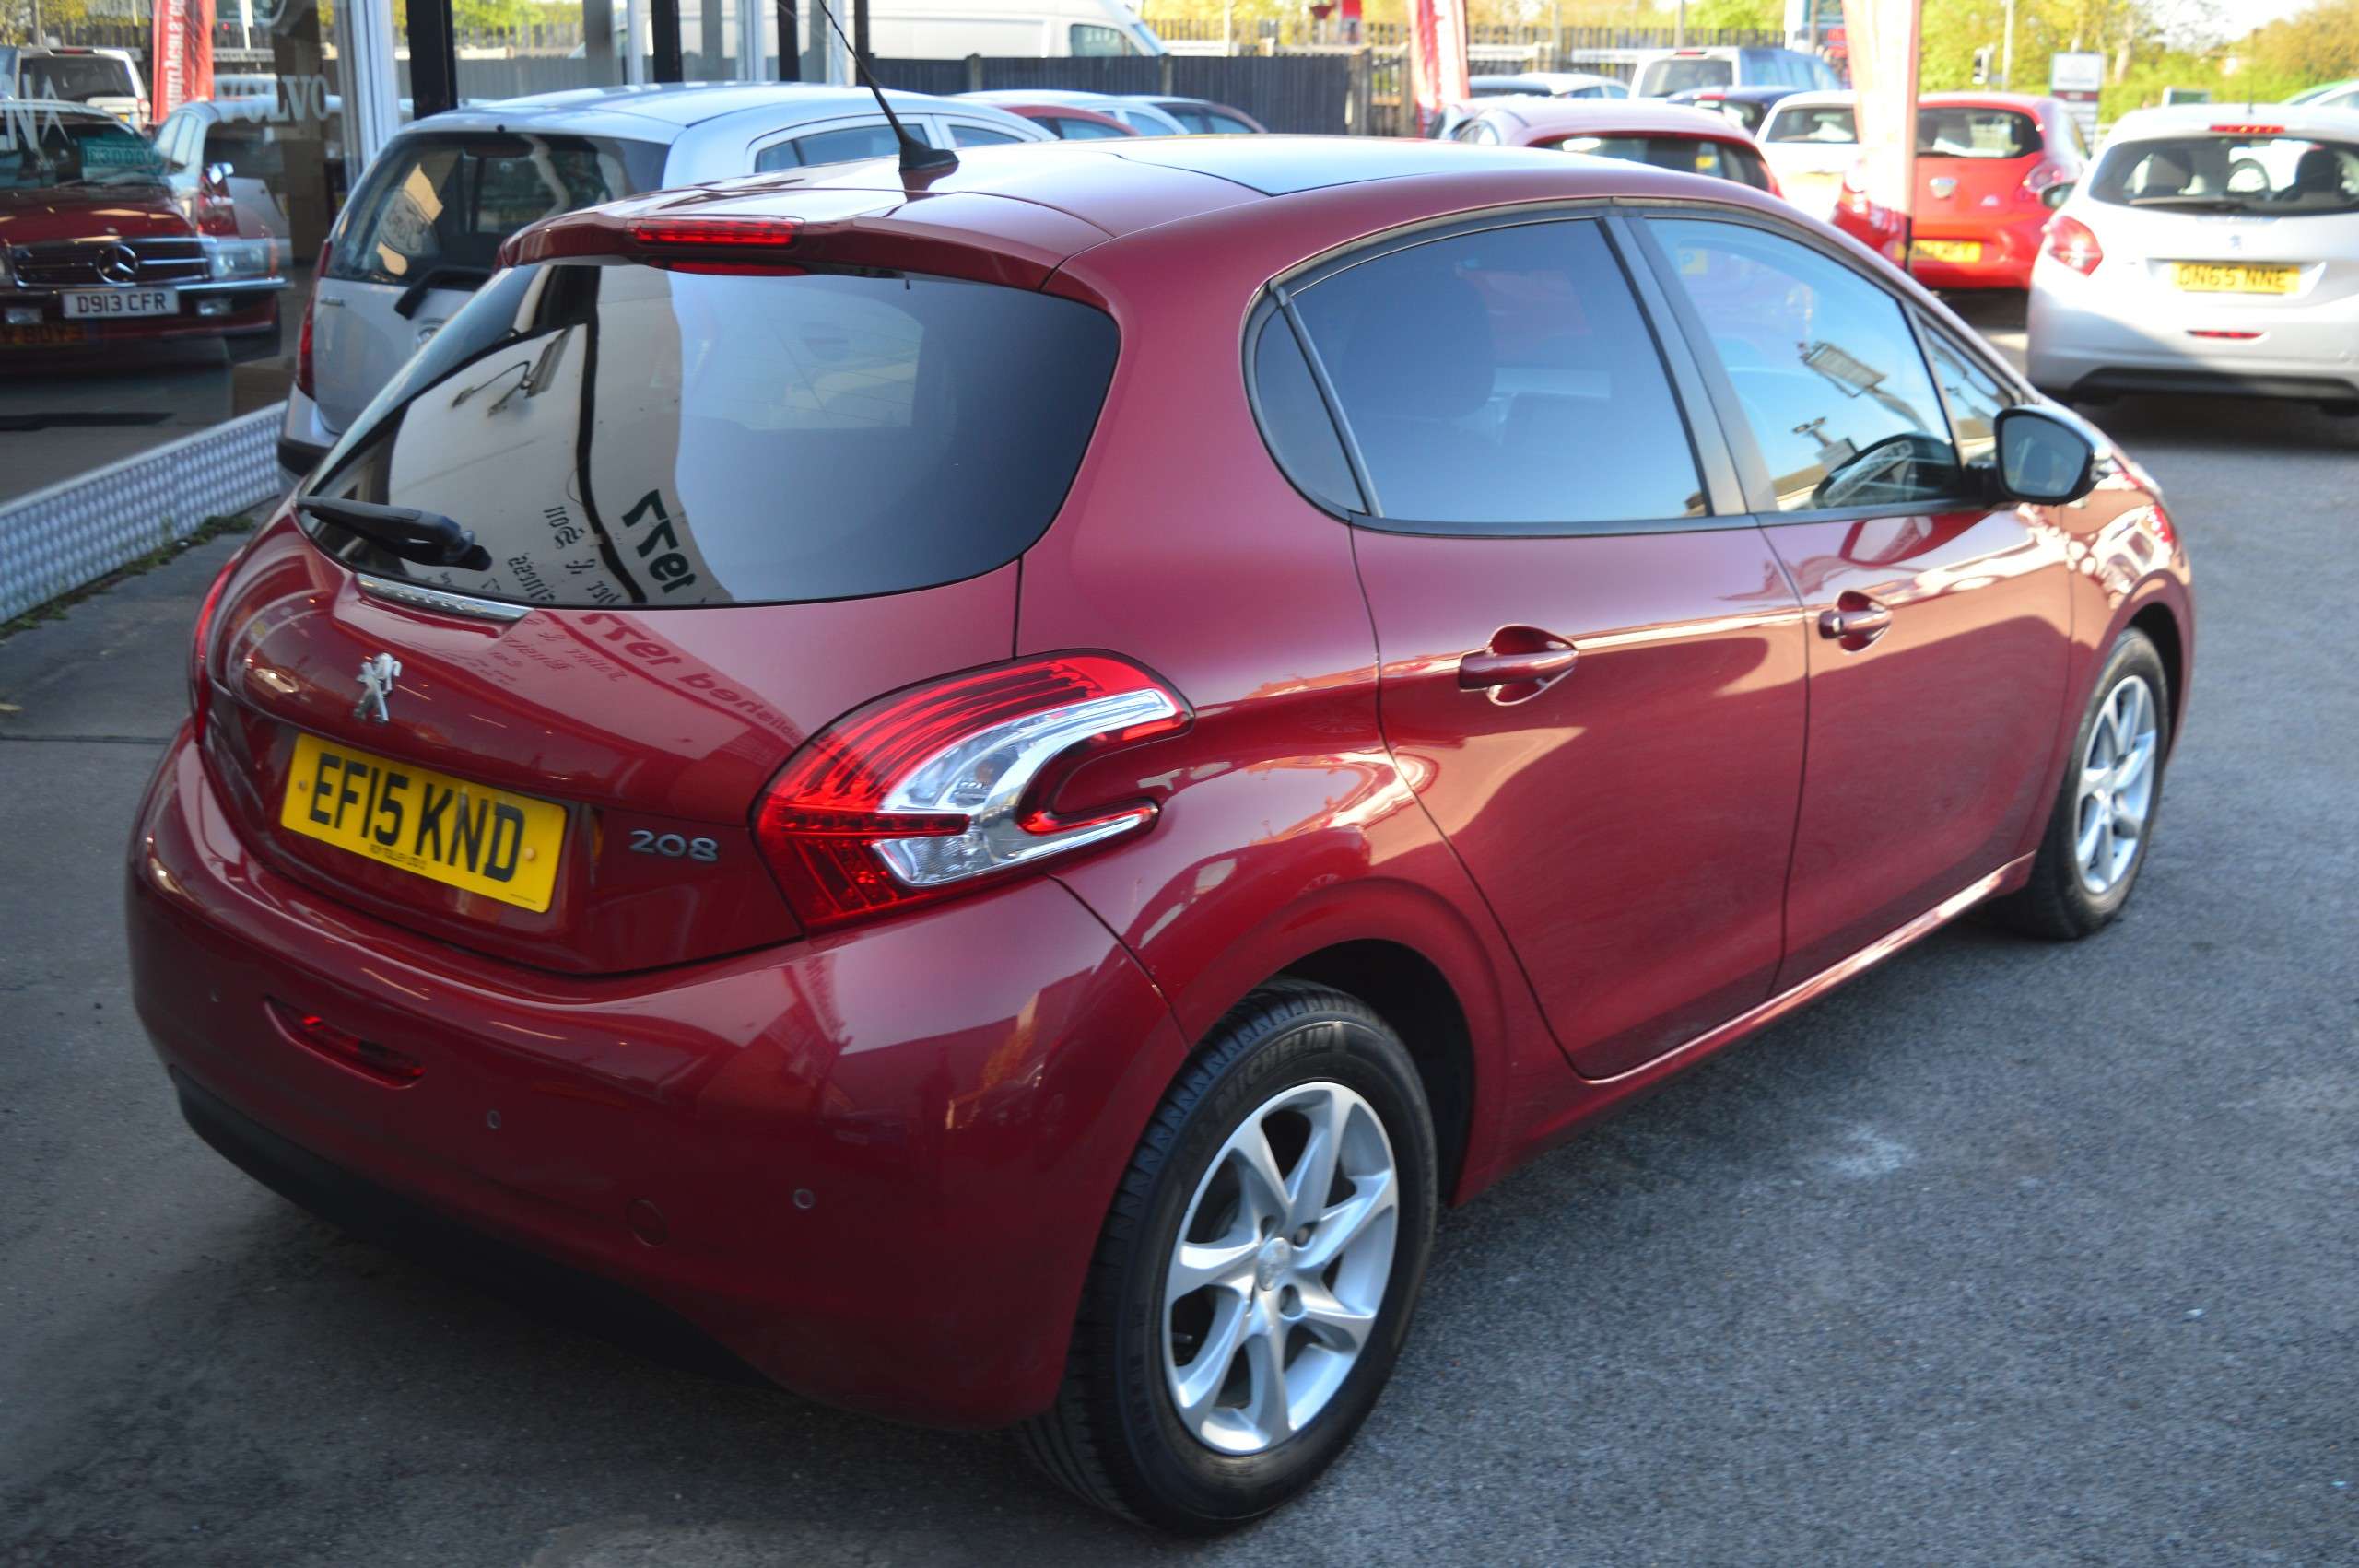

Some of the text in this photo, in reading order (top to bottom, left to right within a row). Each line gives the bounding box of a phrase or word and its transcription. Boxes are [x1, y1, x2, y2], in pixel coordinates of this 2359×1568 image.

[77, 292, 166, 313] D913 CFR
[309, 751, 524, 883] EF15 KND
[628, 829, 718, 861] 208
[1214, 1024, 1336, 1117] MICHELIN
